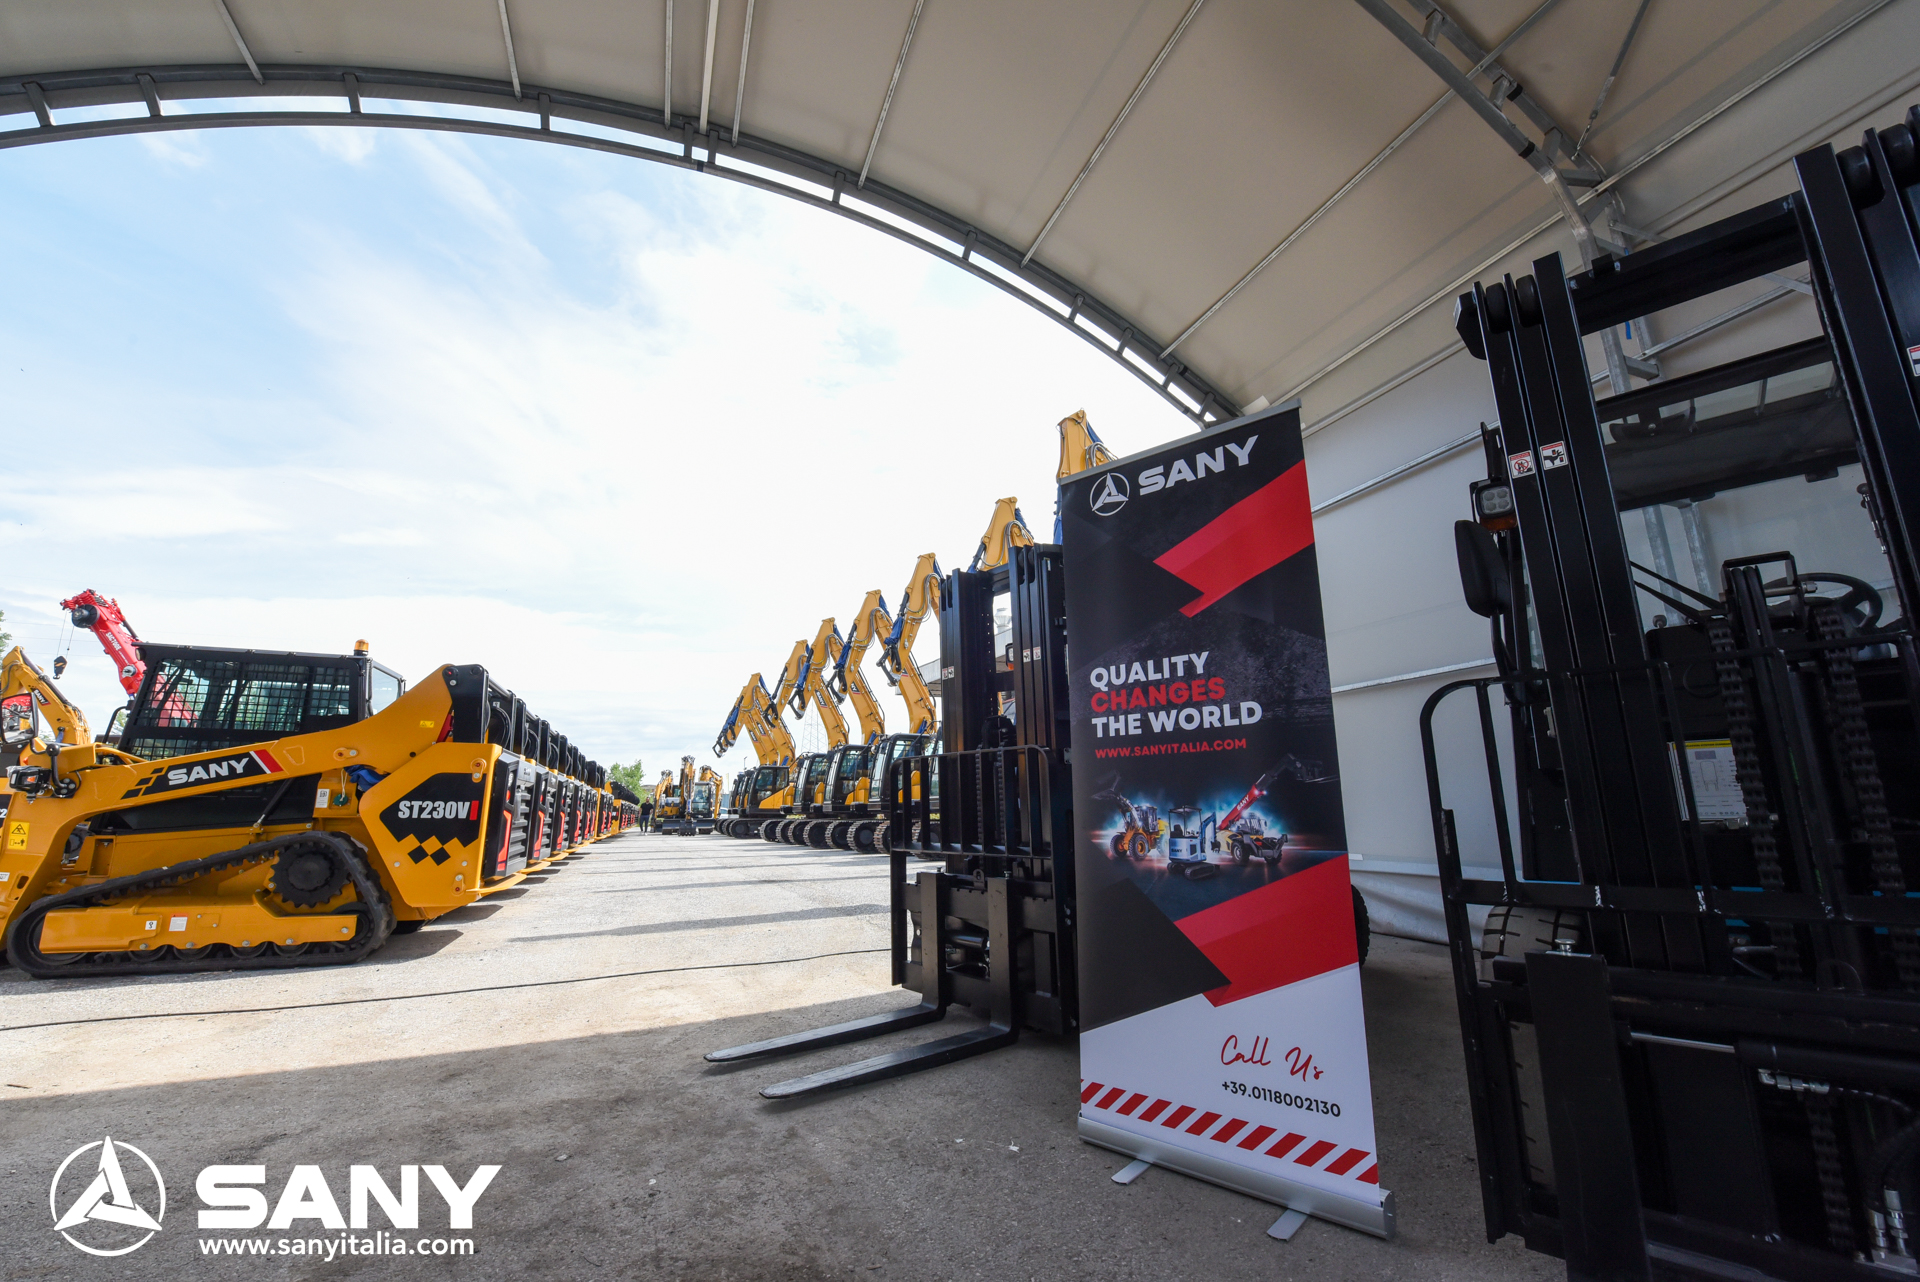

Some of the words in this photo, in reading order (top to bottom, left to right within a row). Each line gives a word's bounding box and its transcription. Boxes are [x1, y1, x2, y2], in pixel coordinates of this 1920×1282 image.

[1138, 435, 1259, 496] SANY
[1090, 651, 1209, 691] QUALITY
[1091, 677, 1226, 713] CHANGES
[1092, 713, 1142, 738] THE
[1148, 701, 1263, 733] WORLD
[1095, 738, 1247, 758] WWW.SANYITALIA.COM
[167, 757, 249, 785] SANY
[1221, 1035, 1271, 1066] Call
[1285, 1047, 1324, 1082] Us
[1222, 1081, 1341, 1117] +39.0118002130
